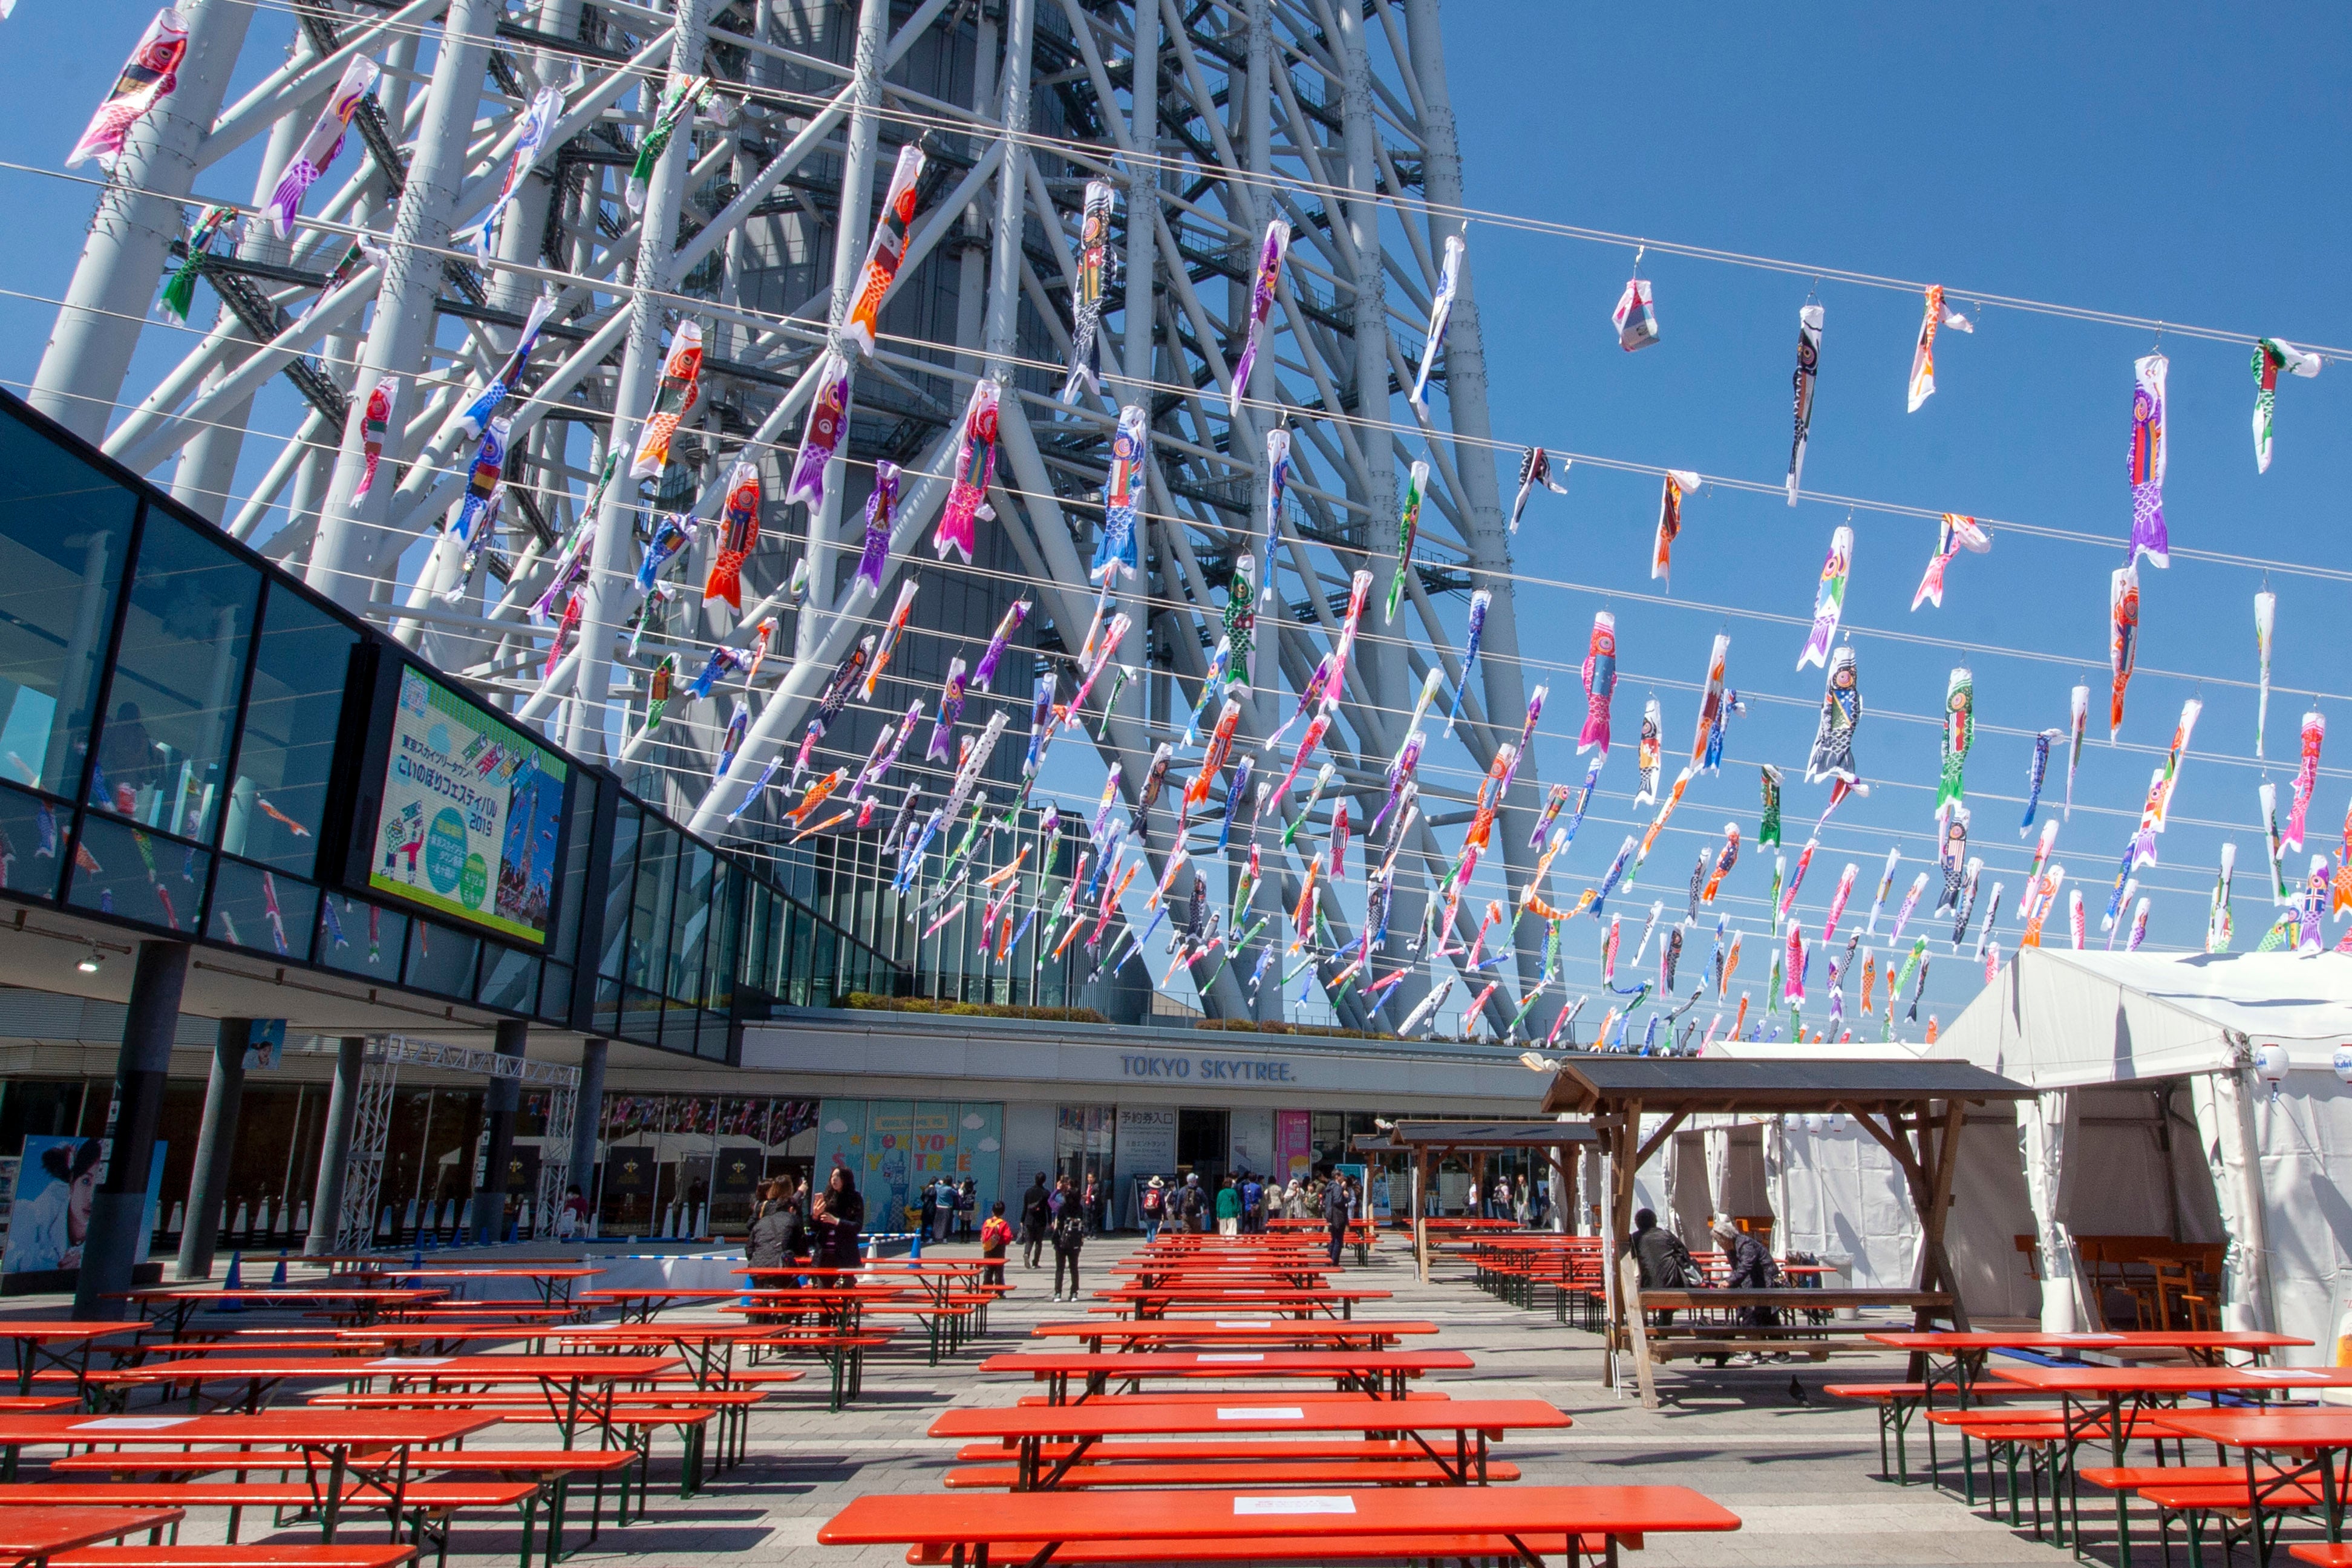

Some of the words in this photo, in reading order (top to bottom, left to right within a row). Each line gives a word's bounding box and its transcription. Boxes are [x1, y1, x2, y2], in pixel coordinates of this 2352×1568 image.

[398, 754, 497, 818] こいのぼりフェスティバル
[469, 812, 493, 837] 2019
[1122, 1056, 1191, 1077] TOKYO
[872, 1134, 946, 1152] TOKYO
